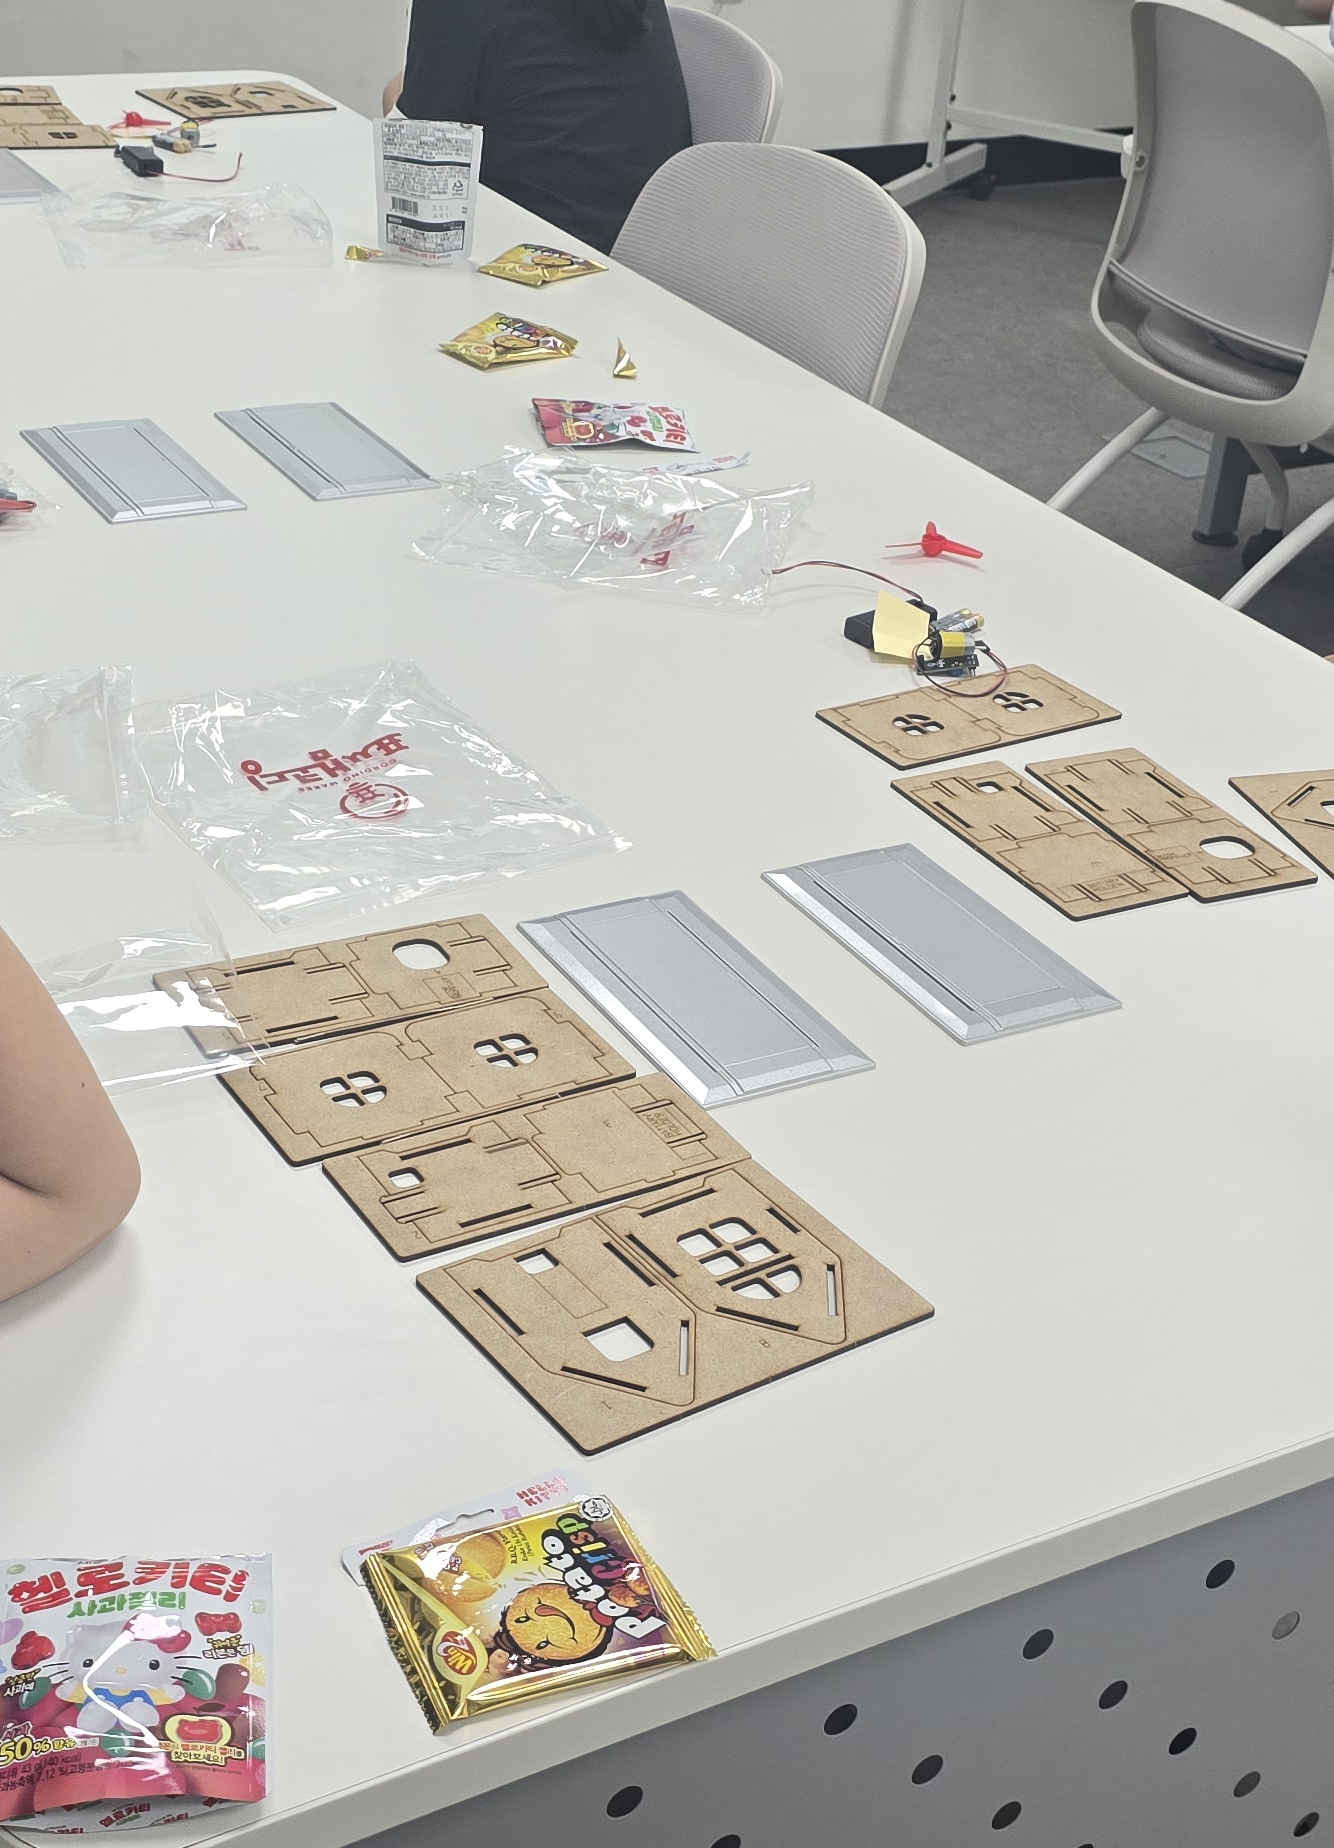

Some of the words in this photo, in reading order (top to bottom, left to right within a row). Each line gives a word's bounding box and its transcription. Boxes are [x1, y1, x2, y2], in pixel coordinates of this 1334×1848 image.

[557, 1517, 634, 1585] Crisp
[7, 1560, 251, 1614] 헬로키티
[66, 1591, 187, 1618] 사과젤리
[542, 1535, 667, 1640] Potato
[173, 1750, 224, 1764] 찾아보세요!
